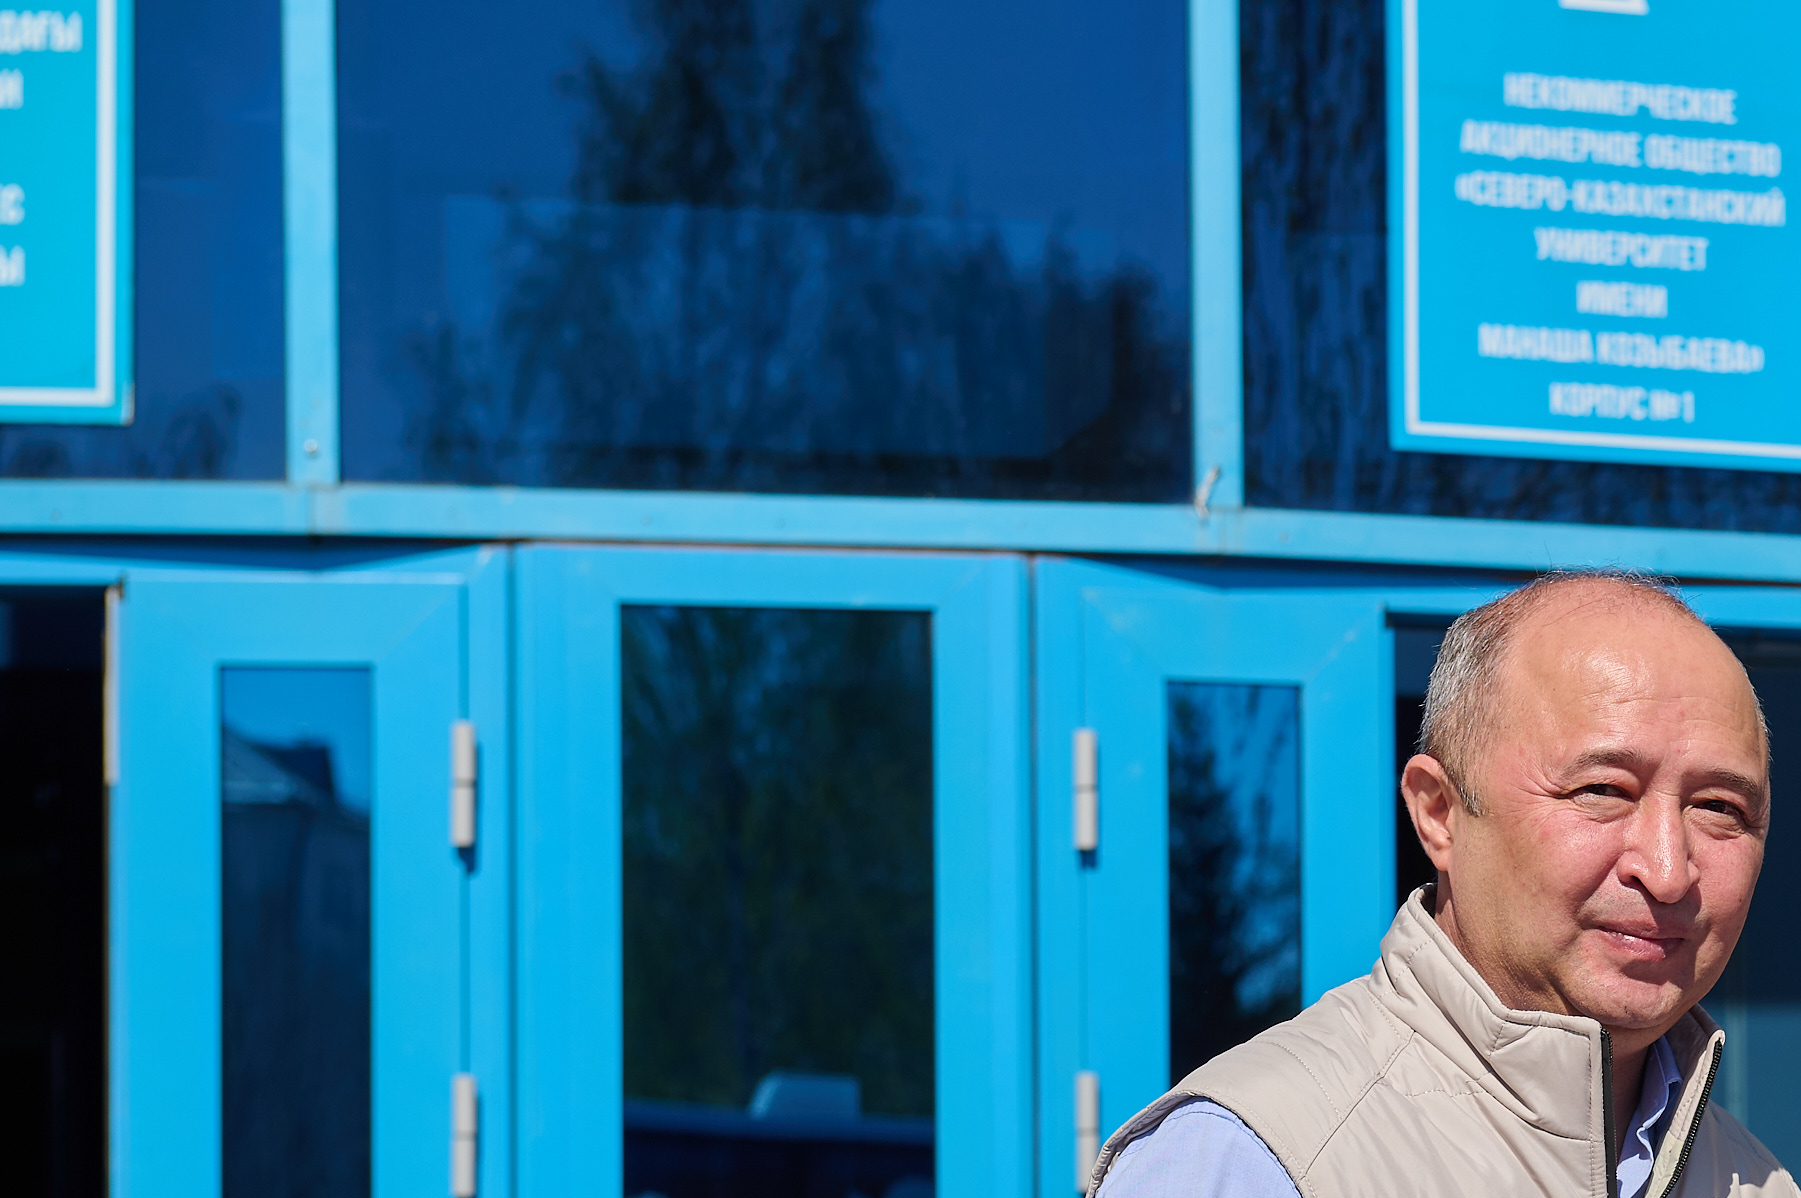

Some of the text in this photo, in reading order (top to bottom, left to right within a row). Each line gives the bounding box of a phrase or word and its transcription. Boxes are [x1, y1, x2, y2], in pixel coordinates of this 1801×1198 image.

[1459, 119, 1782, 178] АКЦИОНЕРНОЕ ОБЩЕСТВО
[1533, 226, 1709, 271] УНИВЕРСИТЕТ
[1576, 280, 1668, 319] ИМЕНИ
[1478, 322, 1594, 363] МАНАША
[1549, 382, 1647, 421] КОРПУС
